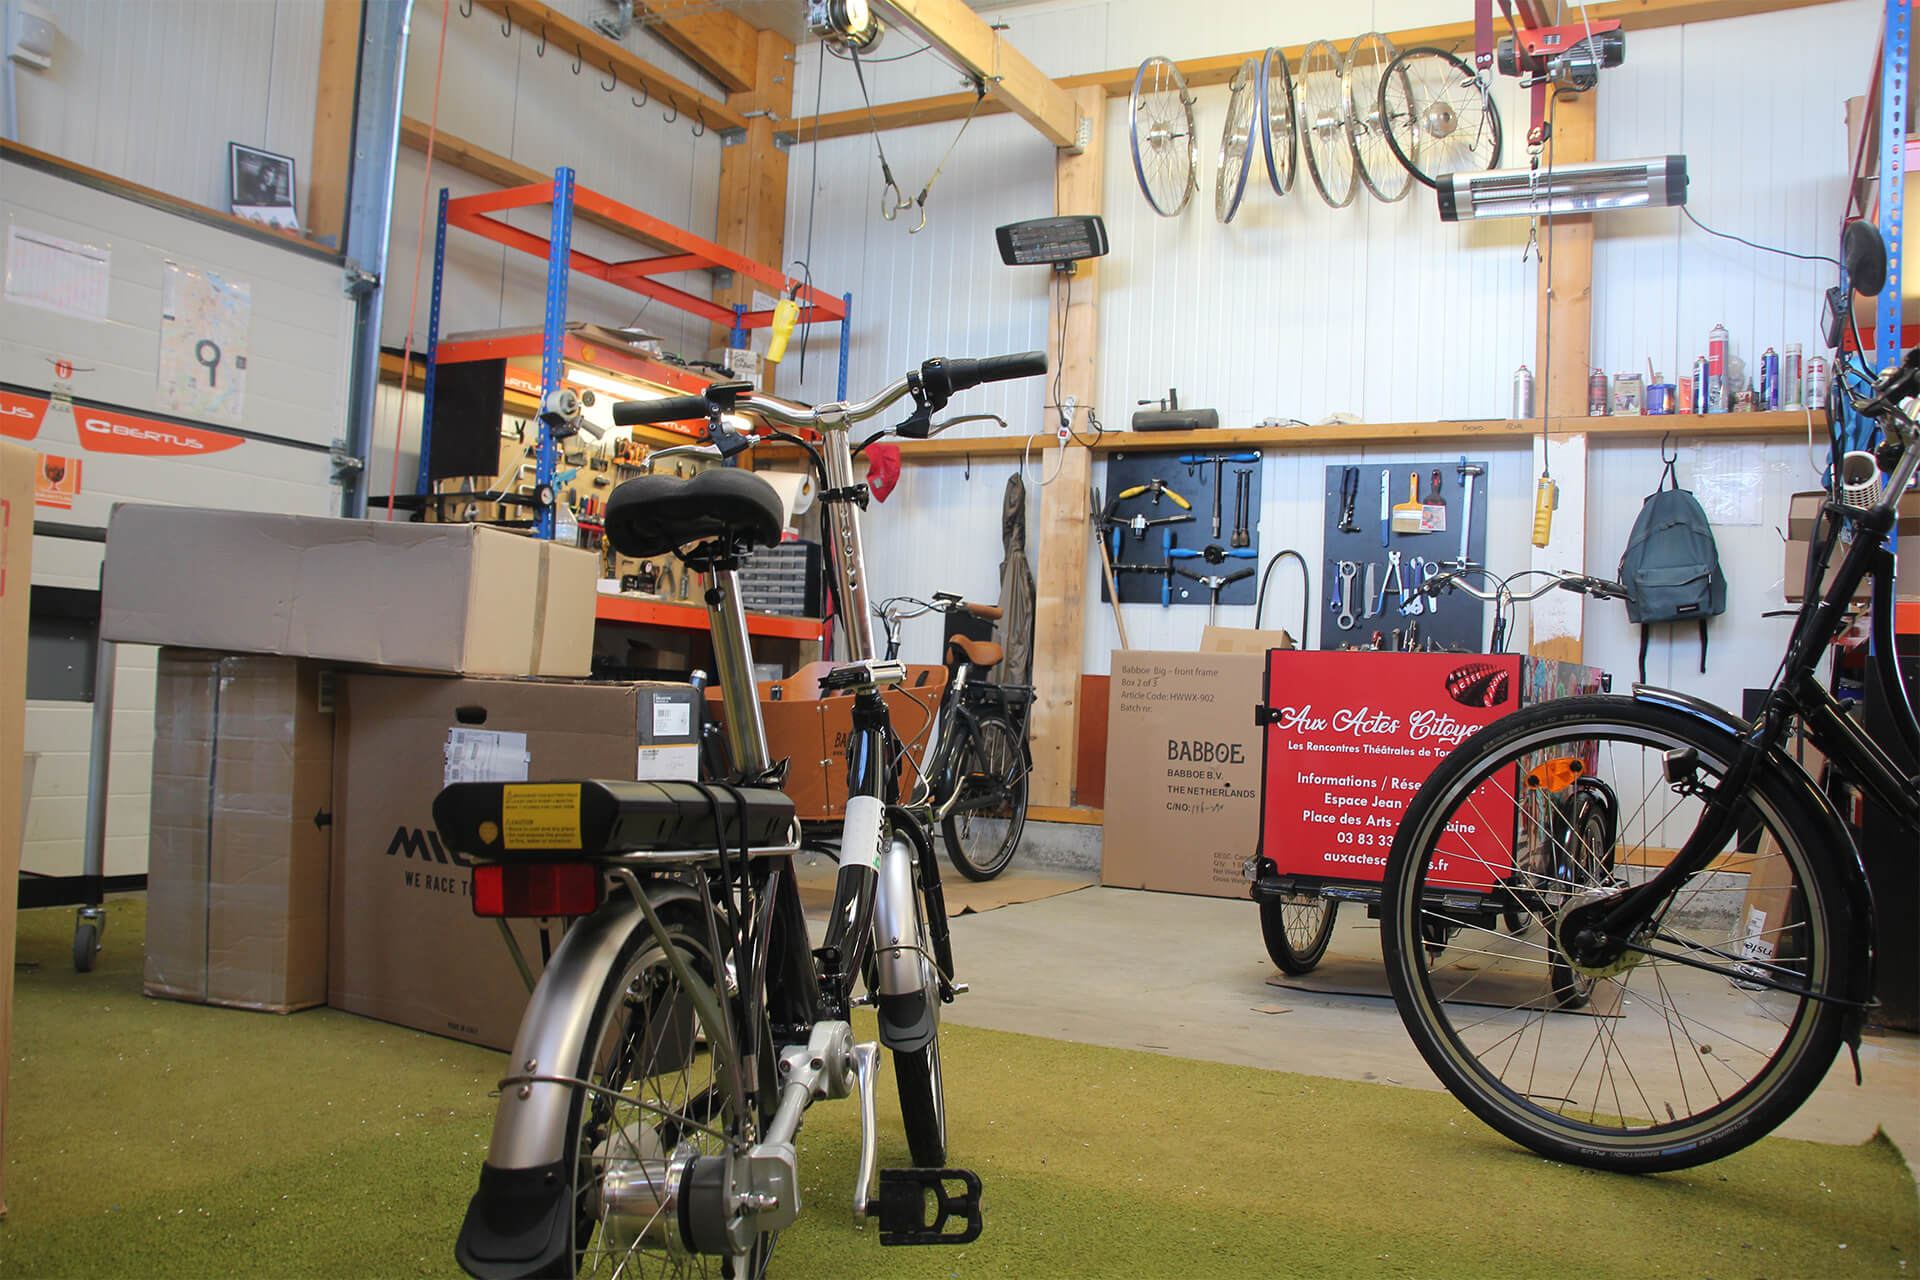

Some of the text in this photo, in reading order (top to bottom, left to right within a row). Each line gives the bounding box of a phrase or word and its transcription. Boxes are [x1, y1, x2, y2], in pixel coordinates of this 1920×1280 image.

[1121, 664, 1151, 674] Babboe
[1153, 664, 1167, 677] Big
[1174, 666, 1193, 677] front
[1195, 667, 1219, 677] frame
[1121, 678, 1135, 687] Box
[1136, 679, 1142, 687] 2
[1143, 679, 1151, 687] of
[1121, 691, 1215, 703] Article Code: HWWX-902
[1120, 703, 1141, 713] Batch
[1277, 705, 1484, 746] Aux Actes Citoye
[1167, 739, 1246, 764] BABBOE
[1288, 741, 1303, 751] Les
[1306, 742, 1360, 754] Rencontres
[1363, 744, 1415, 757] Théâtrales
[1418, 747, 1431, 757] de
[1167, 769, 1224, 780] BABBOE B.V.
[1297, 772, 1377, 788] Informations
[1381, 776, 1388, 791] /
[1391, 777, 1422, 791] Rése
[1168, 785, 1256, 799] THE NETHERLANDS
[1324, 793, 1402, 809] Espace Jean
[1303, 810, 1336, 824] Place
[1339, 812, 1361, 825] des
[1366, 815, 1392, 828] Arts
[1336, 832, 1394, 847] 03 83 33
[405, 871, 420, 888] WE
[426, 874, 455, 893] RACE
